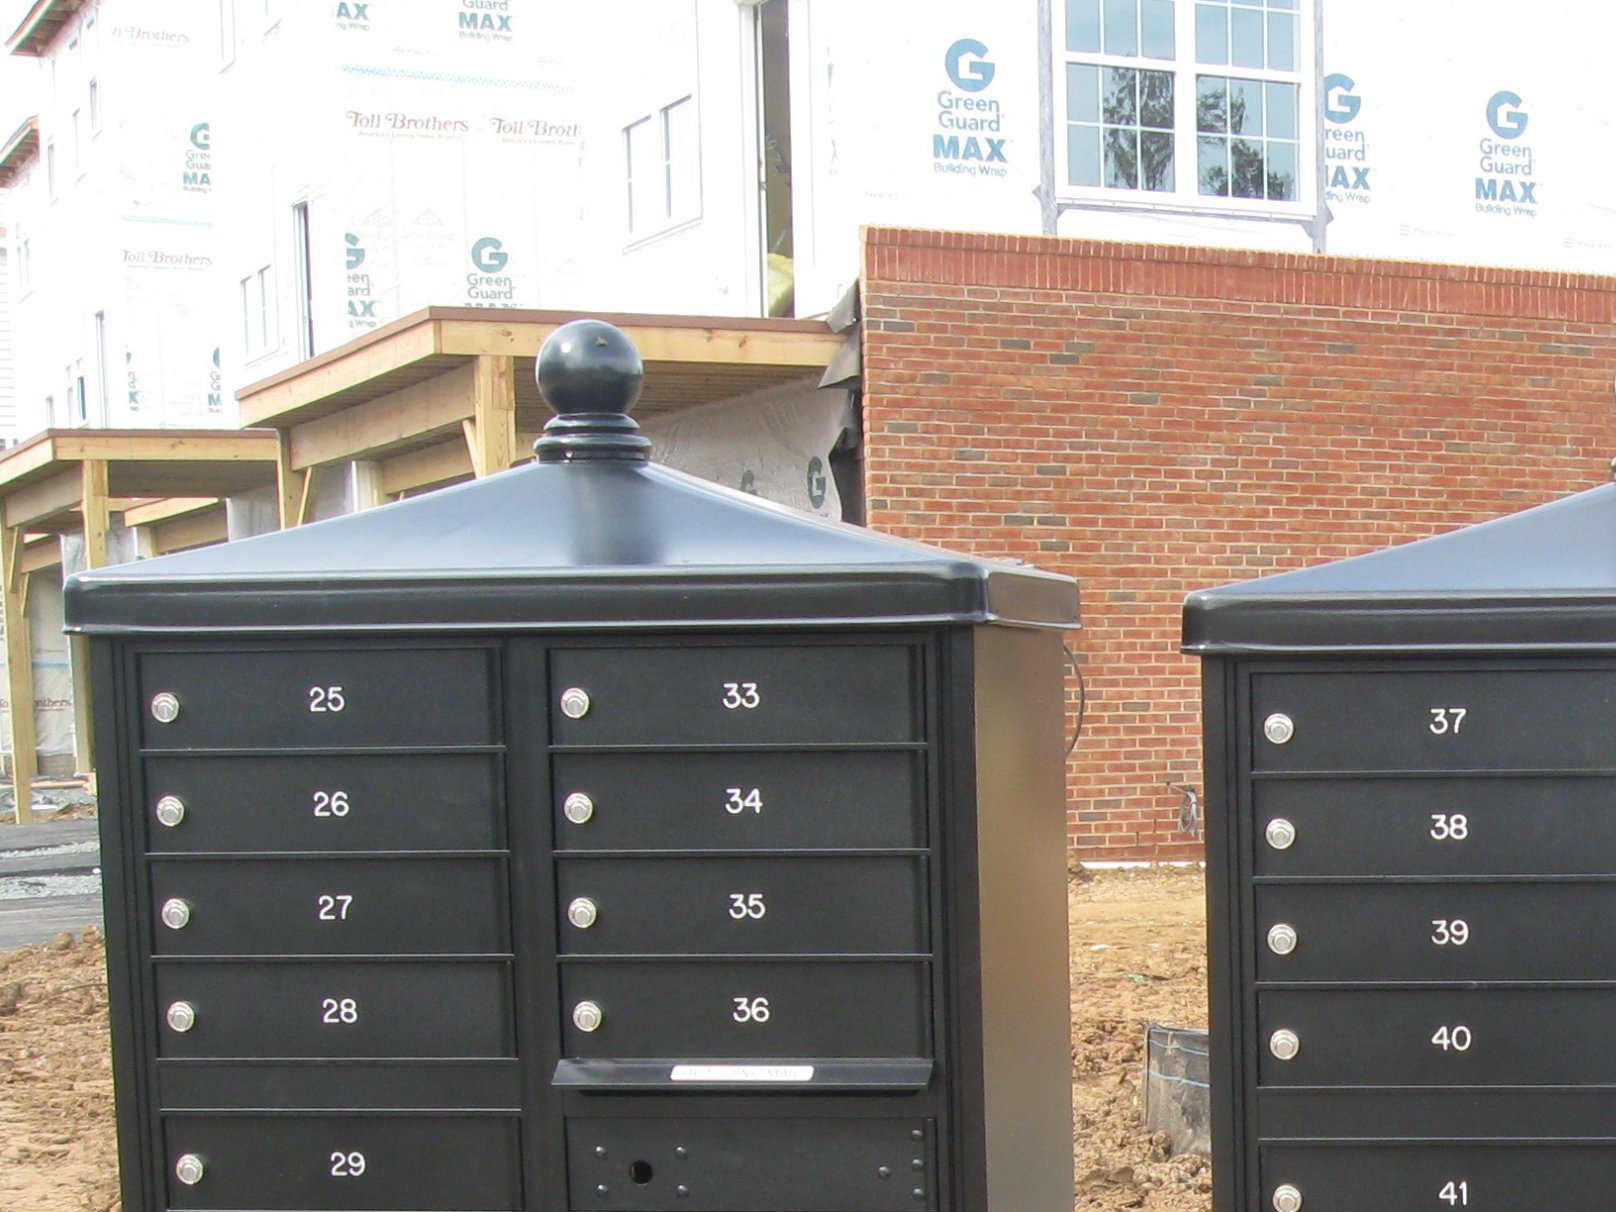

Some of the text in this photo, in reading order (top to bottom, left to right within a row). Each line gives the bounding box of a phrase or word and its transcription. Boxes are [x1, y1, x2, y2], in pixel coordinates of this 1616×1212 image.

[336, 1, 370, 21] AX
[458, 11, 513, 32] MAX
[124, 26, 190, 43] Brothers
[937, 90, 1001, 113] Green
[346, 110, 470, 133] Toll Brothers
[490, 117, 578, 137] Toll Brot
[938, 110, 1001, 133] Guard
[1325, 128, 1365, 144] reen
[185, 149, 210, 160] Gre
[932, 133, 1009, 164] MAX
[1325, 143, 1366, 161] uard
[1480, 138, 1532, 158] Green
[185, 159, 211, 170] Gua
[933, 161, 1008, 178] Building Wrap
[1480, 156, 1532, 176] Guard
[182, 171, 211, 186] MA
[1325, 165, 1371, 191] AX
[1345, 192, 1371, 204] Wrap
[1475, 177, 1537, 204] MAX
[1475, 203, 1537, 217] Building Wrap
[122, 249, 213, 266] Toll Brothers
[347, 285, 371, 297] ard
[466, 272, 513, 287] Green
[467, 286, 513, 300] Guard
[348, 299, 377, 317] AX
[309, 686, 345, 712] 25
[722, 682, 760, 709] 33
[1429, 708, 1467, 735] 37
[313, 790, 350, 817] 26
[725, 788, 764, 814] 34
[1430, 813, 1468, 841] 38
[318, 894, 353, 921] 27
[728, 893, 766, 920] 35
[1431, 919, 1469, 946] 39
[322, 998, 358, 1024] 28
[732, 996, 770, 1023] 36
[1431, 1025, 1472, 1051] 40
[330, 1151, 366, 1177] 29
[1438, 1180, 1468, 1206] 41
